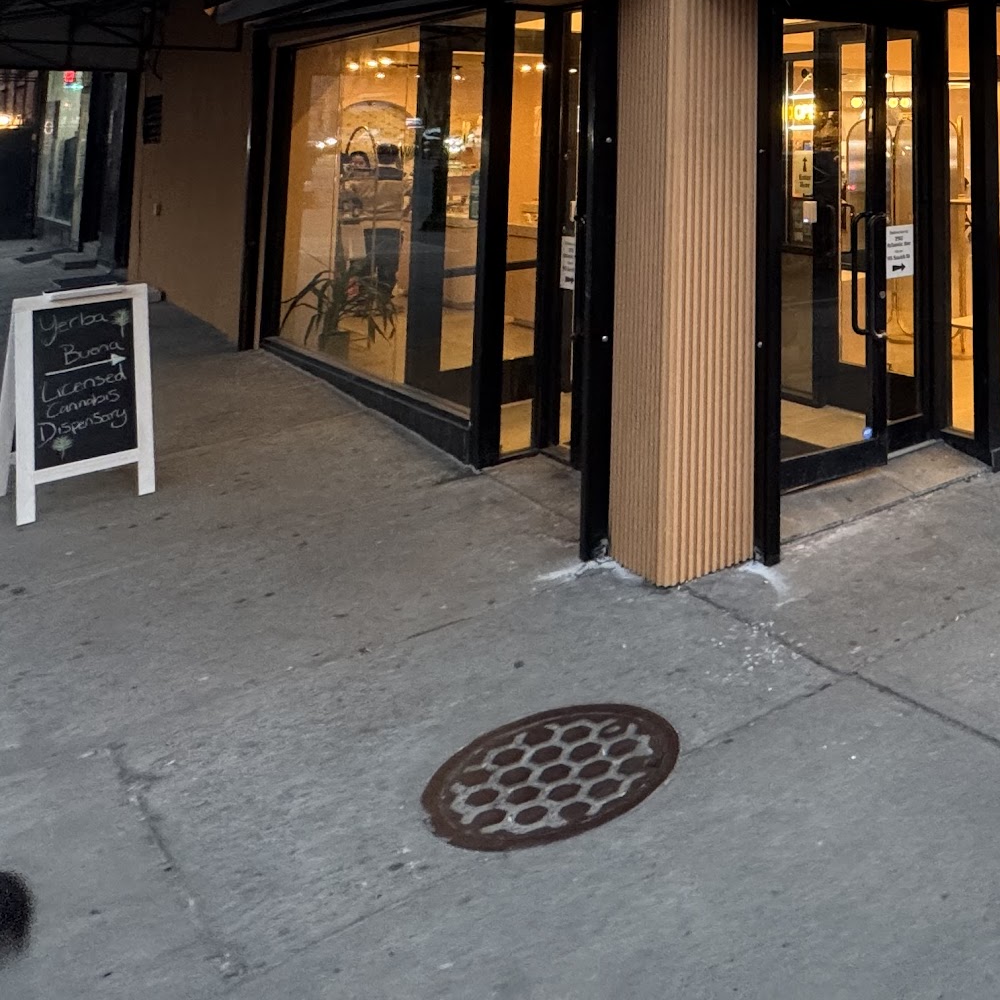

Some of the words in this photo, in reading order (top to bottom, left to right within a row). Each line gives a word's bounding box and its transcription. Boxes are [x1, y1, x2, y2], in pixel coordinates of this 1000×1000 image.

[38, 312, 108, 347] Yerba
[41, 363, 127, 403] Licensed
[46, 388, 121, 418] Cannabis
[37, 408, 127, 449] Dispensary
